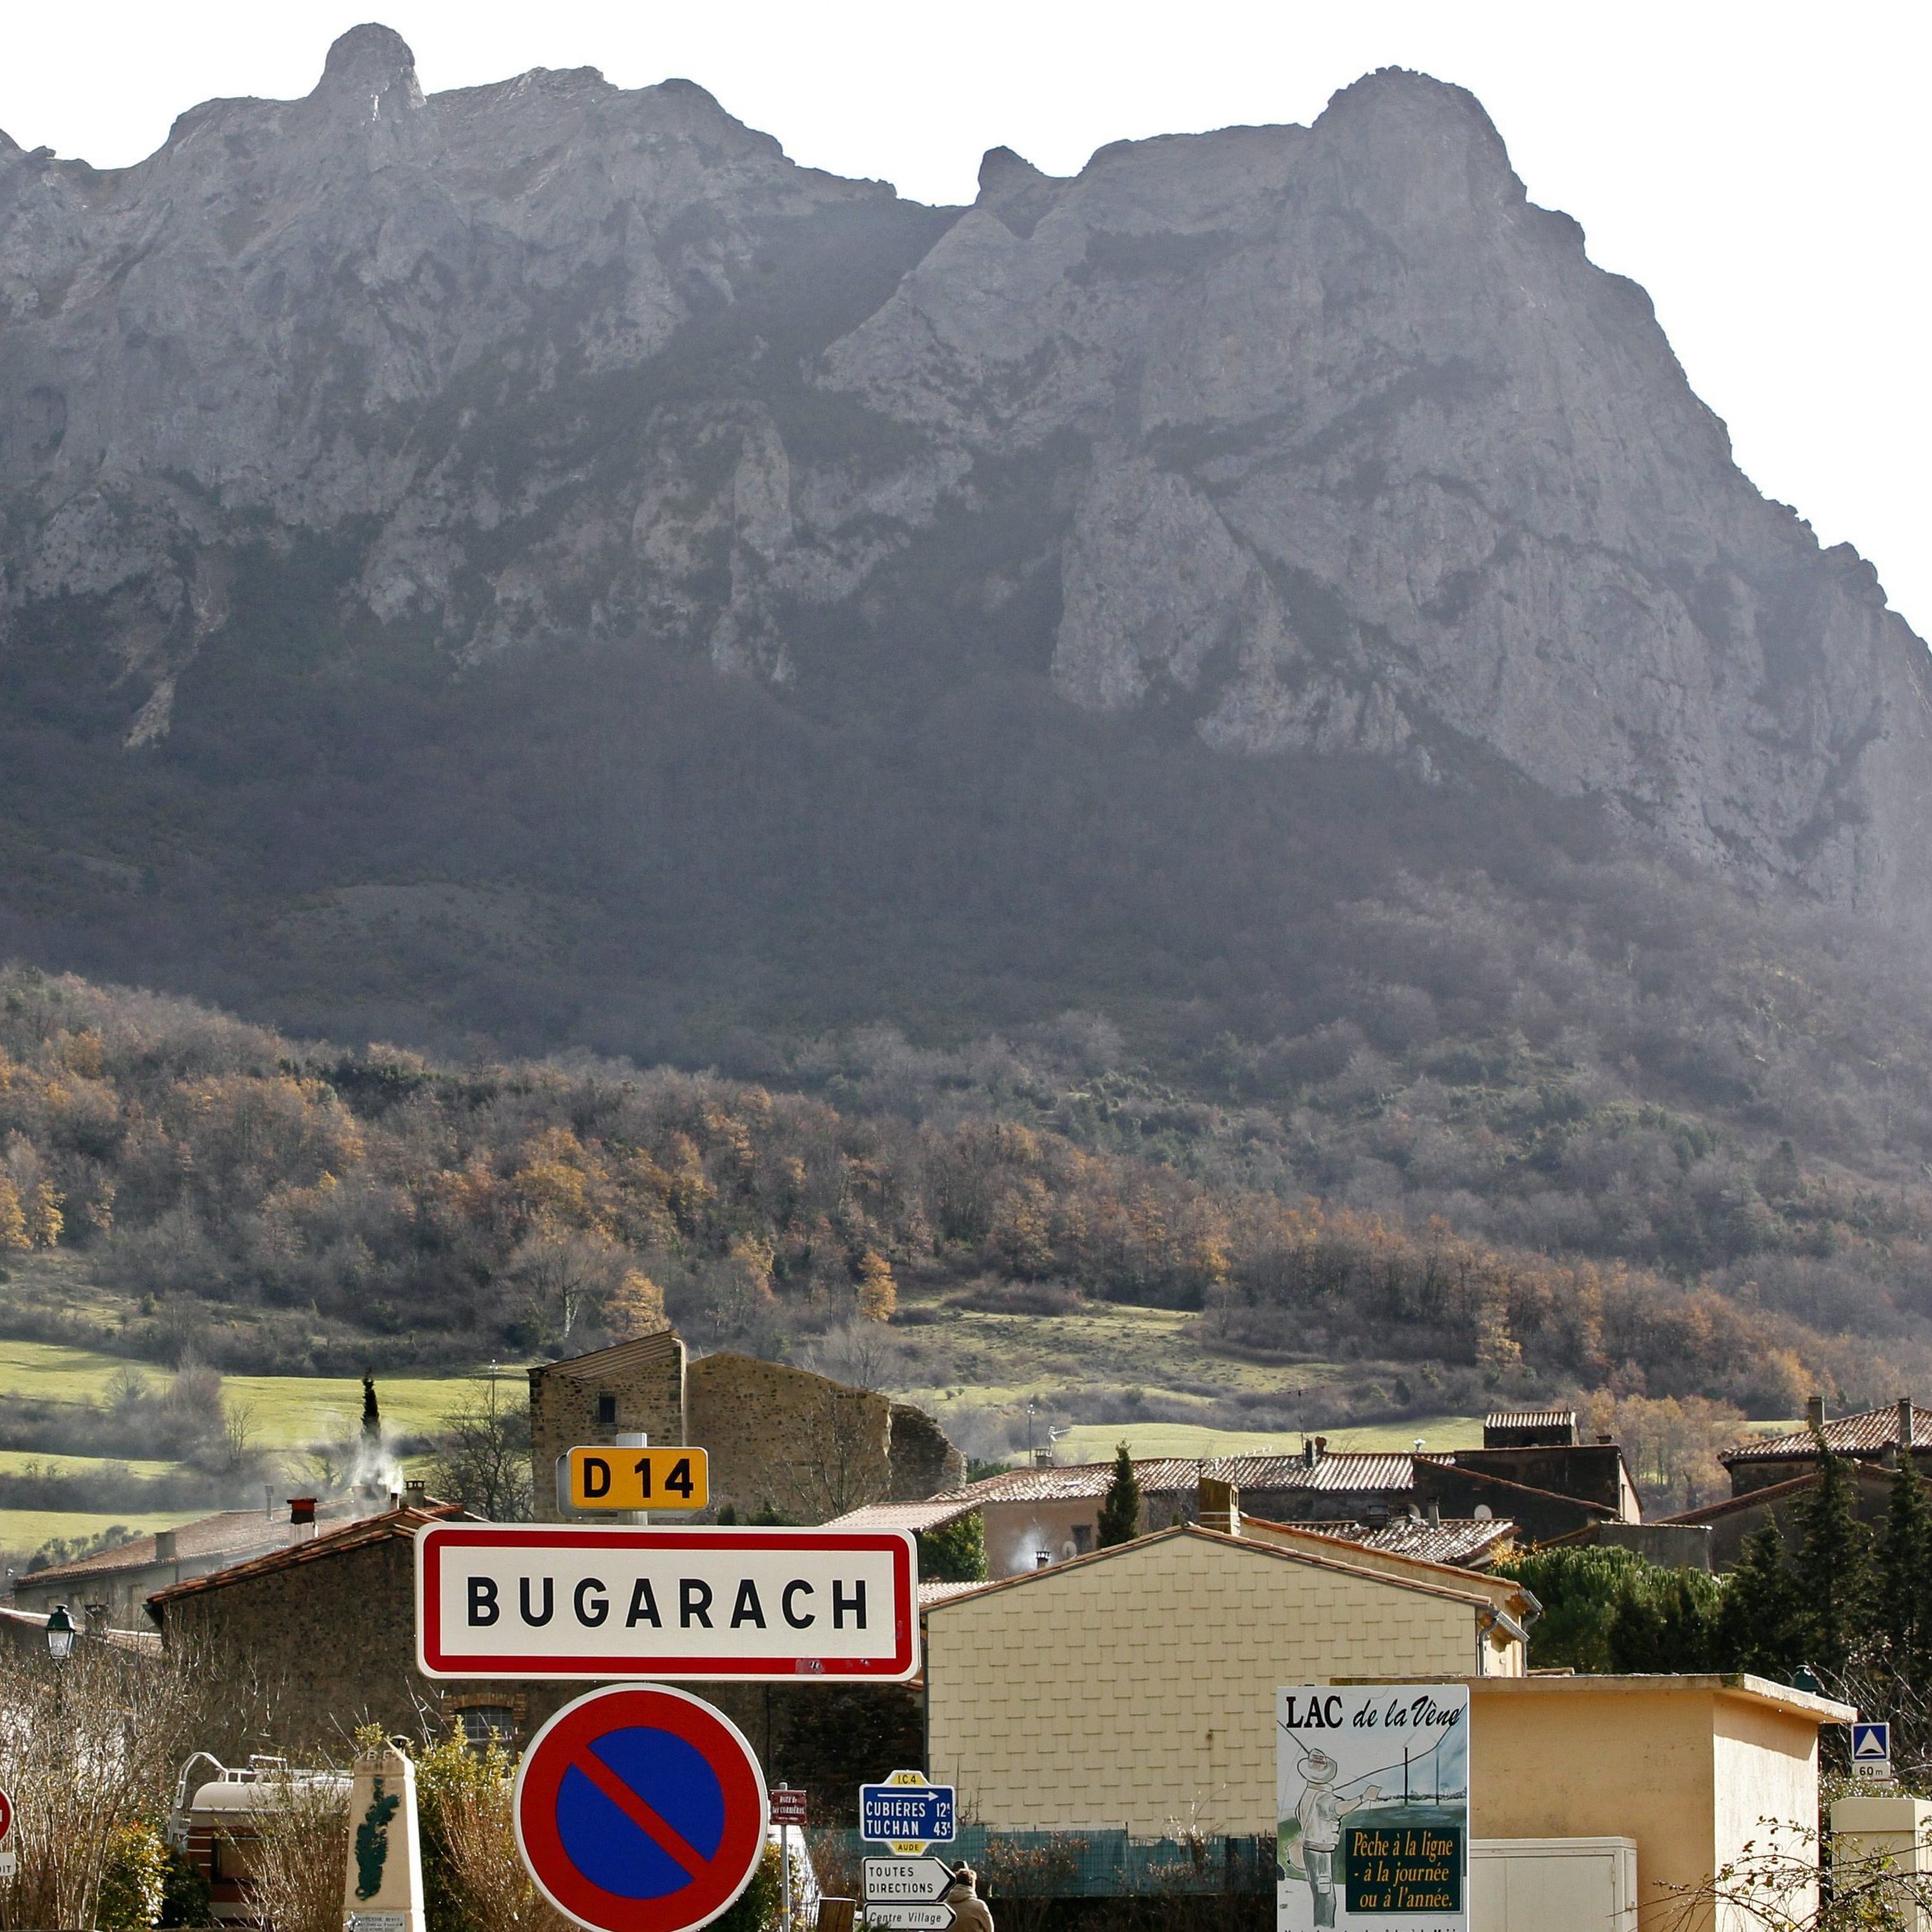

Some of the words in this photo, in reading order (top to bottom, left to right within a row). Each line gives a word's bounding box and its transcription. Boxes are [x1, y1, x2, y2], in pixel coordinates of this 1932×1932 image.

[583, 1458, 611, 1498] D
[634, 1458, 694, 1499] 14
[467, 1577, 867, 1629] BUGARACH
[1286, 1696, 1342, 1729] LAC
[1352, 1699, 1378, 1729] de
[1384, 1698, 1406, 1727] la
[1411, 1695, 1460, 1727] Vène
[1859, 1766, 1873, 1776] 60
[866, 1820, 919, 1836] TUCHAN
[1352, 1831, 1388, 1856] Pêche
[1393, 1833, 1400, 1855] à
[1405, 1832, 1417, 1856] la
[1422, 1832, 1453, 1862] ligne
[869, 1867, 914, 1877] TOUTES
[1363, 1863, 1372, 1882] à
[1377, 1861, 1389, 1882] la
[1393, 1863, 1449, 1888] journée
[869, 1883, 933, 1894] DIRECTIONS
[1360, 1894, 1378, 1908] ou
[1383, 1888, 1391, 1908] à
[870, 1912, 902, 1922] Centre
[908, 1912, 942, 1925] Village
